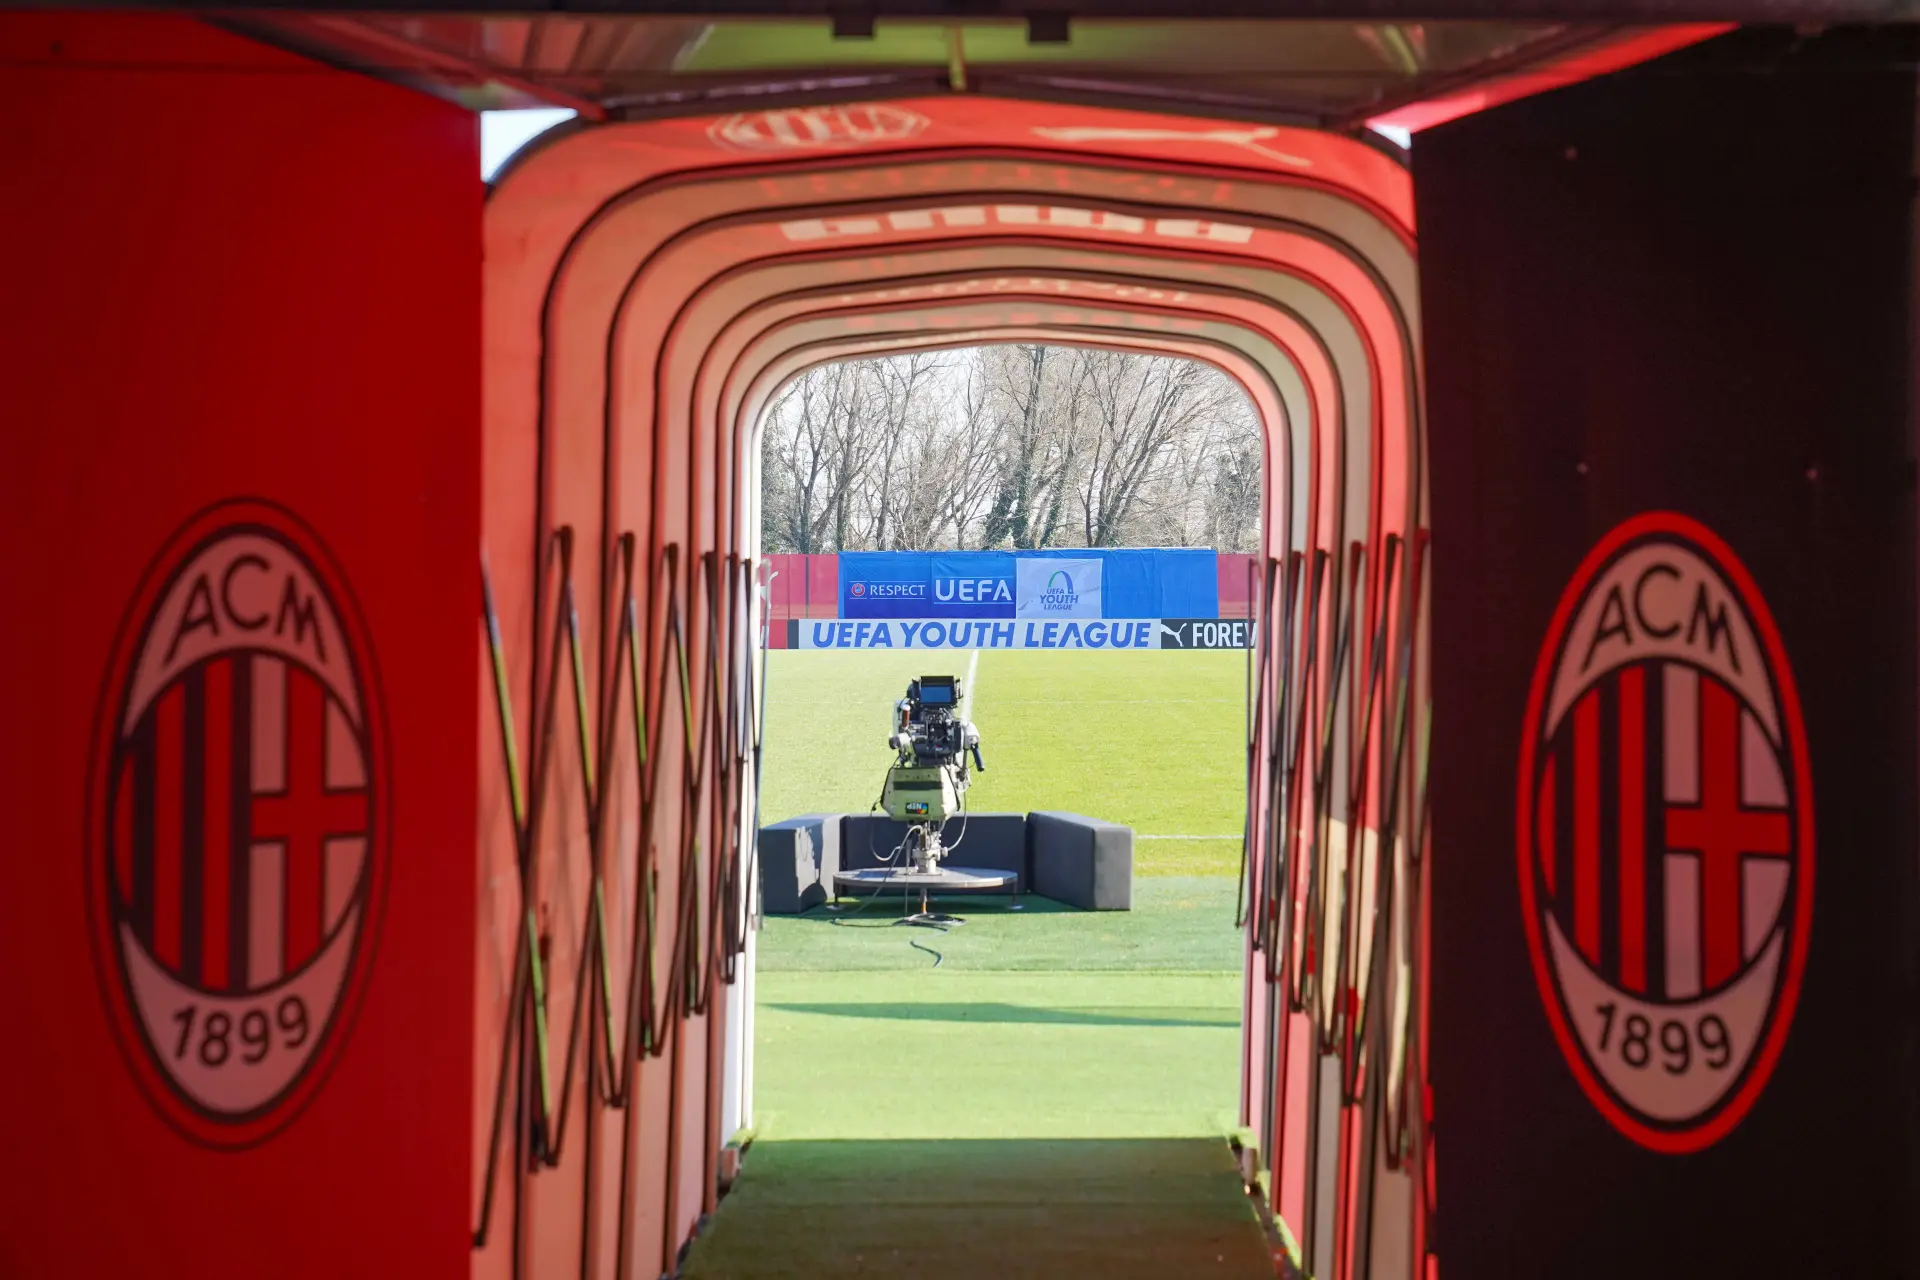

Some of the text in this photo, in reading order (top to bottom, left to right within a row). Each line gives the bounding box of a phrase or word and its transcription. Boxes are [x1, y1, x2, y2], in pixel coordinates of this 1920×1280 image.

[869, 584, 926, 596] RESPECT
[935, 579, 1013, 601] UEFA
[1040, 594, 1079, 604] YOUTH
[162, 554, 328, 669] ACM
[1043, 603, 1072, 611] LEAGUE
[1581, 563, 1742, 676] ACM
[812, 622, 1151, 648] UEFA YOUTH LEAGUE
[171, 995, 310, 1069] 1899
[1595, 1003, 1731, 1077] 1899
